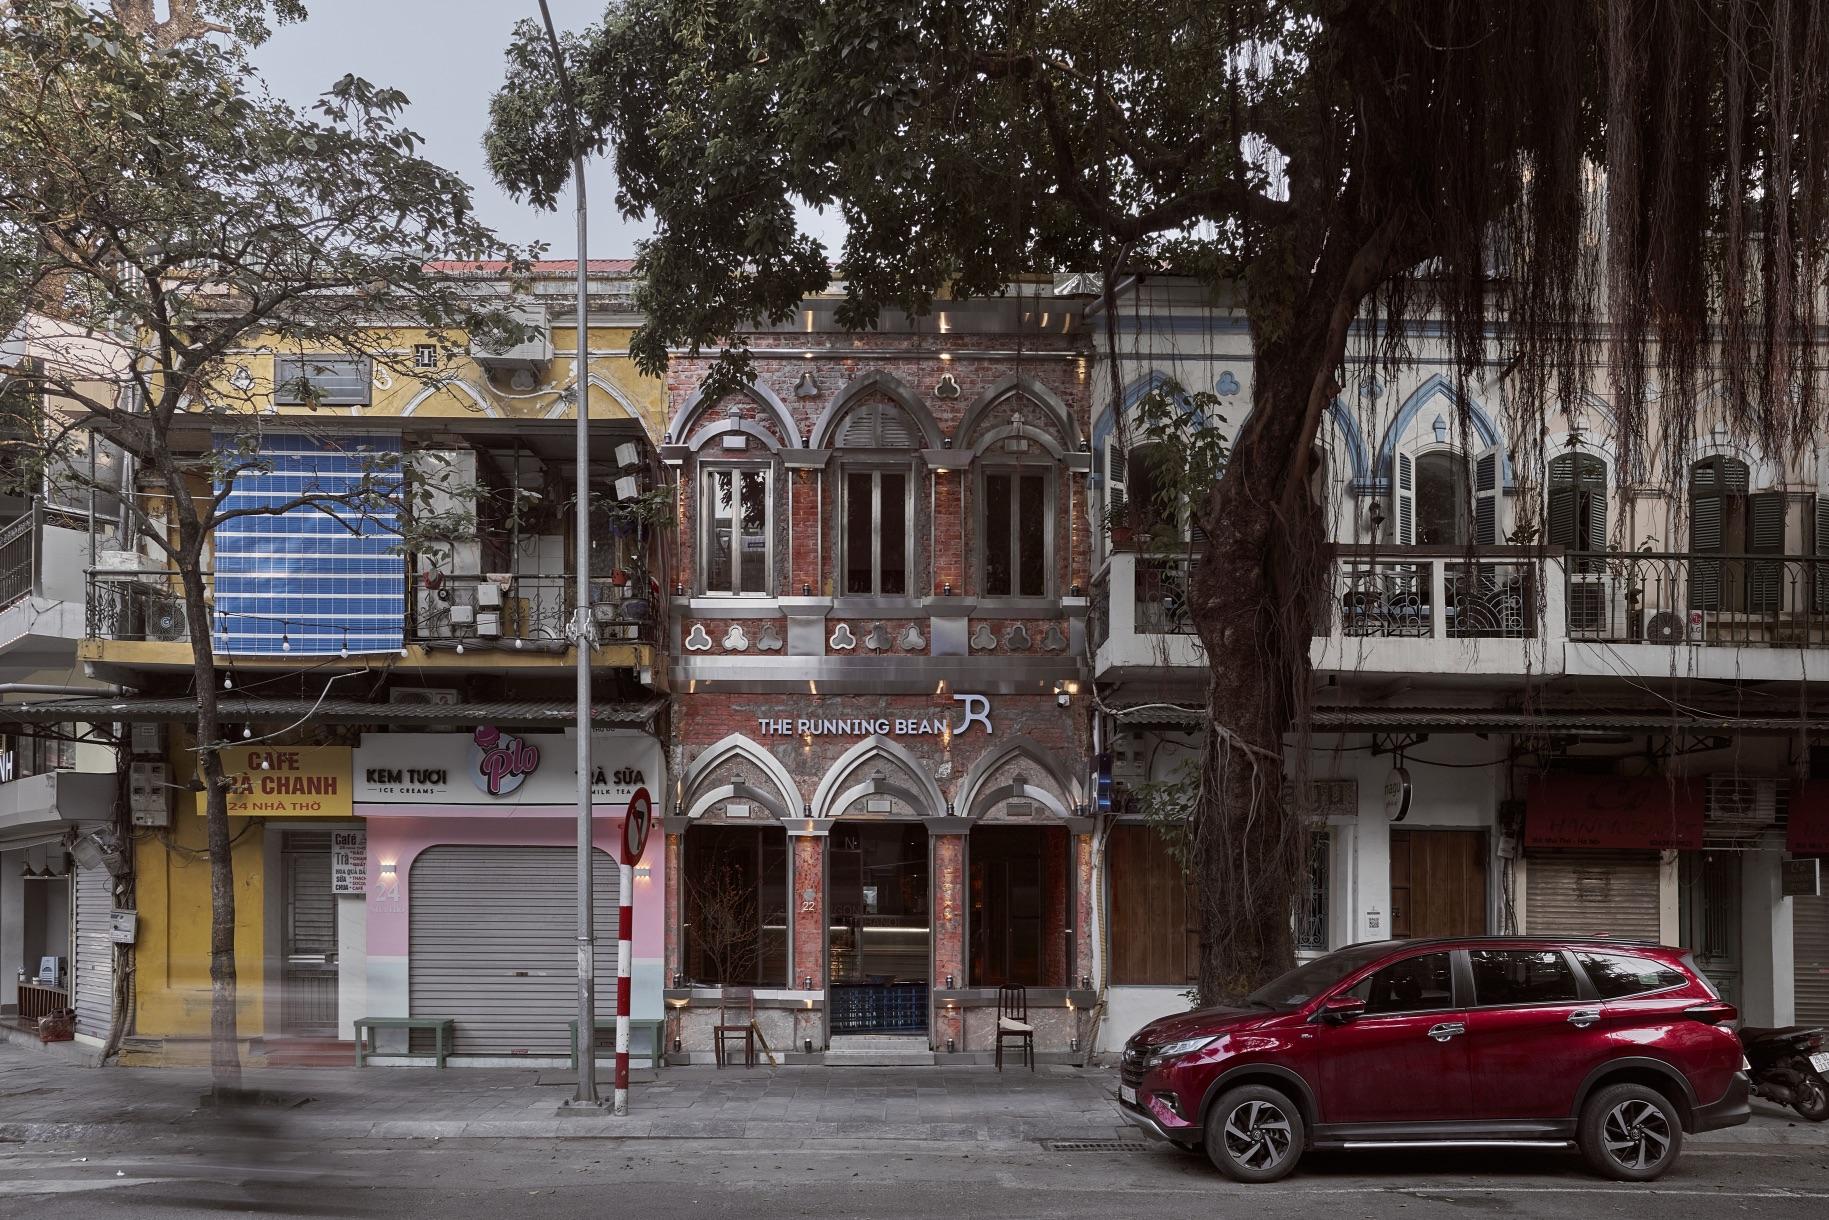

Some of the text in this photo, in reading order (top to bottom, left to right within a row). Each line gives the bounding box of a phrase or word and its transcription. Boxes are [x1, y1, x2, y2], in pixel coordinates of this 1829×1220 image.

[759, 719, 947, 735] THE RUNNING BEAN
[248, 752, 300, 771] CAFE
[366, 769, 402, 784] KEM
[613, 766, 645, 785] SỮA
[261, 776, 337, 795] CHANH
[229, 800, 321, 811] 24 NHÀ THỜ
[335, 833, 357, 846] Café
[375, 882, 401, 902] 24
[802, 901, 816, 912] 22
